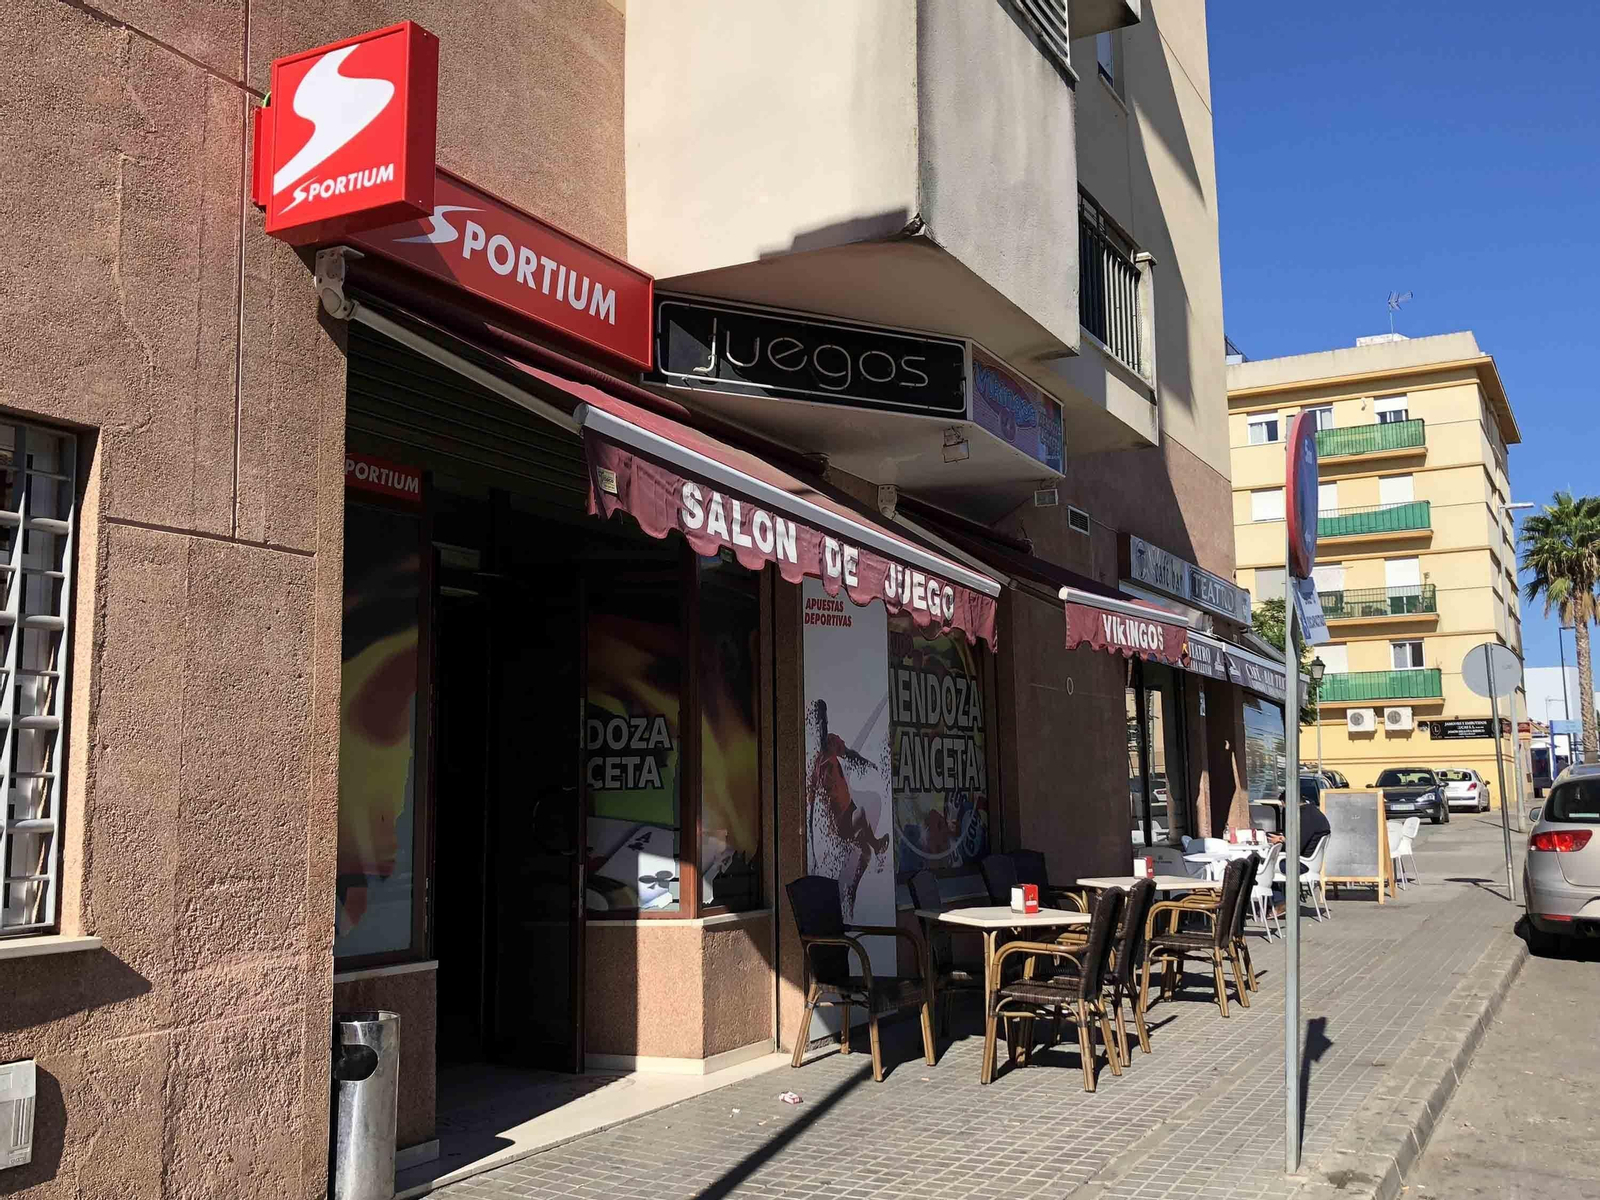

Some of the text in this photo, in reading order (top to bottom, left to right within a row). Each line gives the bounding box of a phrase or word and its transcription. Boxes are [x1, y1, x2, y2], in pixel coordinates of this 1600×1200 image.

[278, 163, 394, 215] SPORTIUM
[393, 205, 616, 326] SPORTIUM
[681, 481, 955, 621] SALON DE JUEGO
[805, 598, 844, 612] APUESTAS
[1192, 572, 1235, 611] TEATRO
[804, 612, 852, 628] DEPORTIVAS
